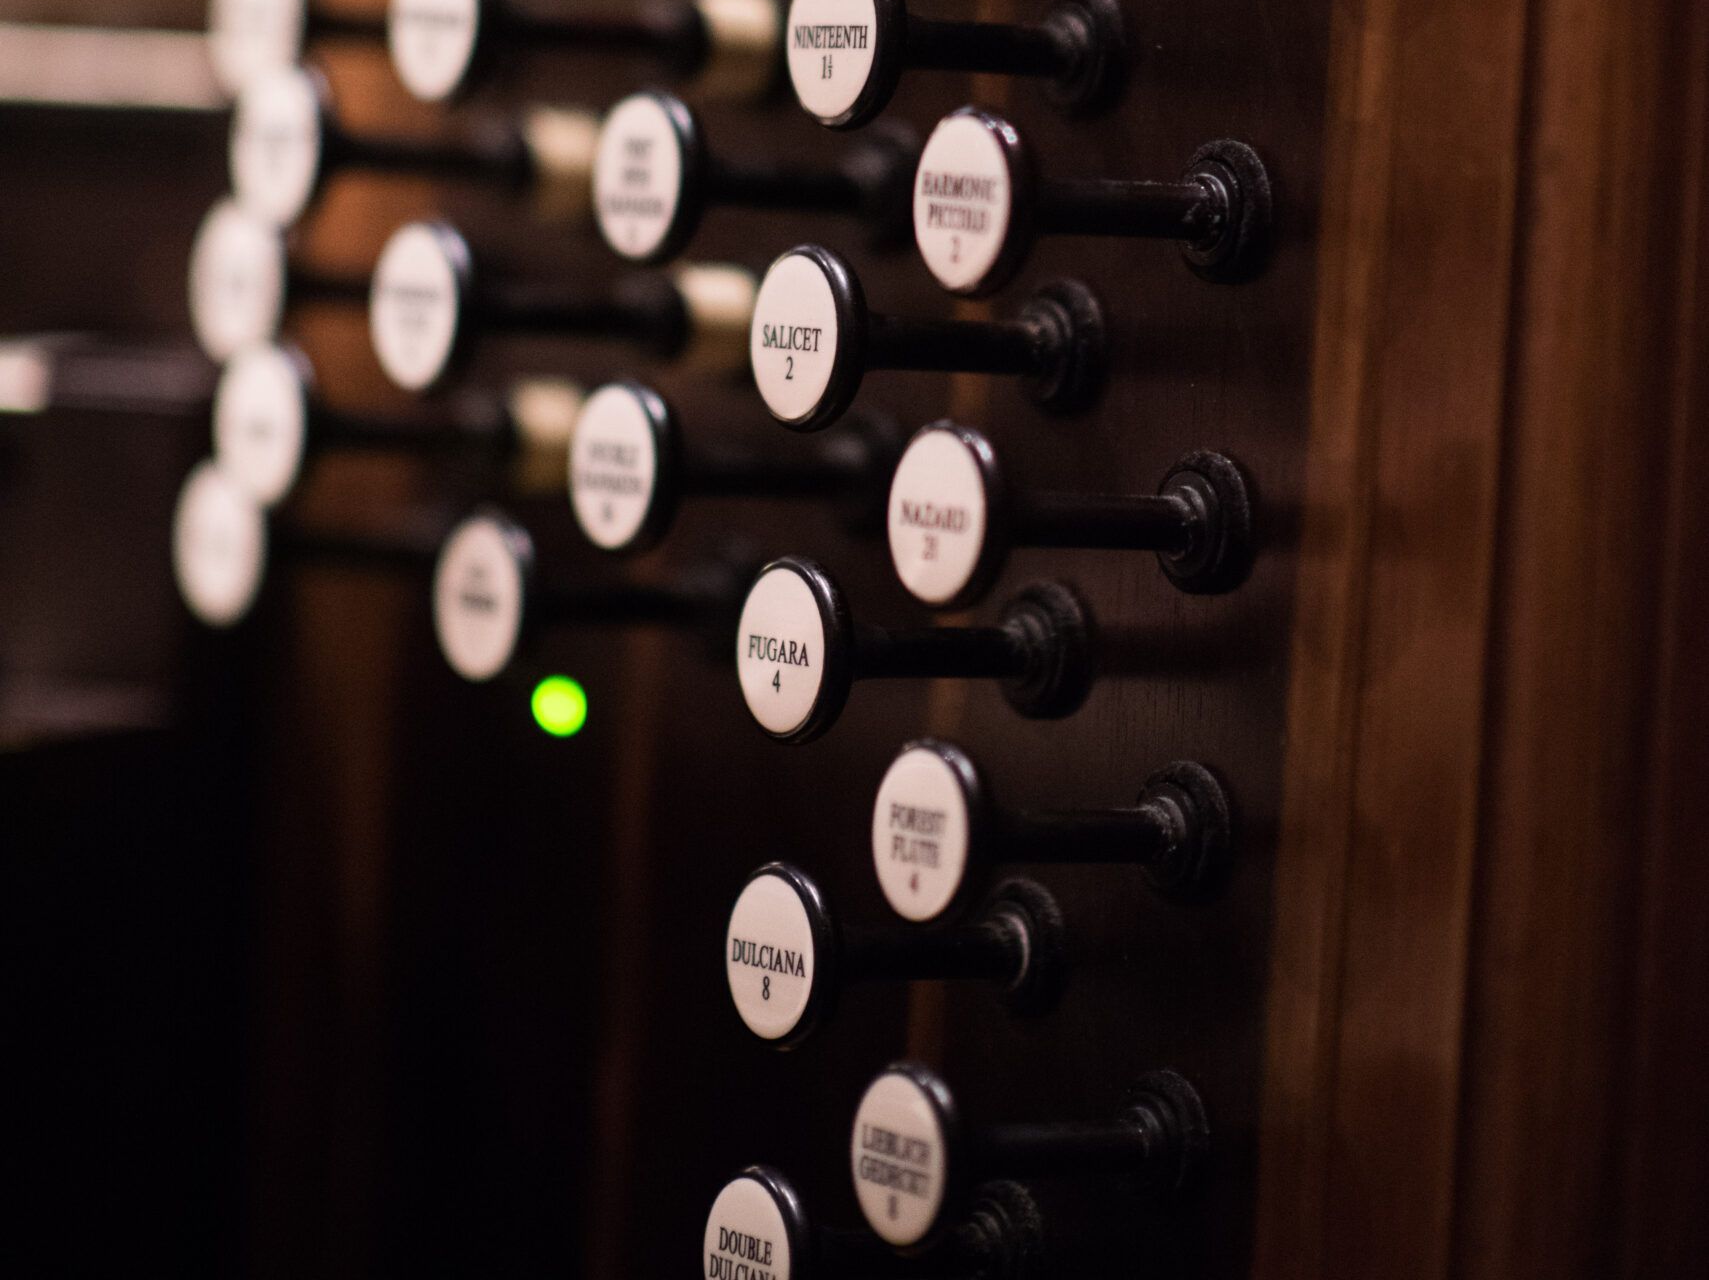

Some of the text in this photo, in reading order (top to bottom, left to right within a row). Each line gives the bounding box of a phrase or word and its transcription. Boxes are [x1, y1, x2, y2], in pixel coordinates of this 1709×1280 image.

[794, 24, 869, 50] NINETEENTH
[762, 323, 822, 353] SALICET
[785, 355, 794, 380] 2
[901, 498, 966, 532] NAZARD
[748, 634, 809, 668] FUGARA
[772, 669, 781, 693] 4
[732, 938, 806, 978] DULCIANA
[762, 975, 770, 1000] 8
[718, 1226, 772, 1266] DOUBLE
